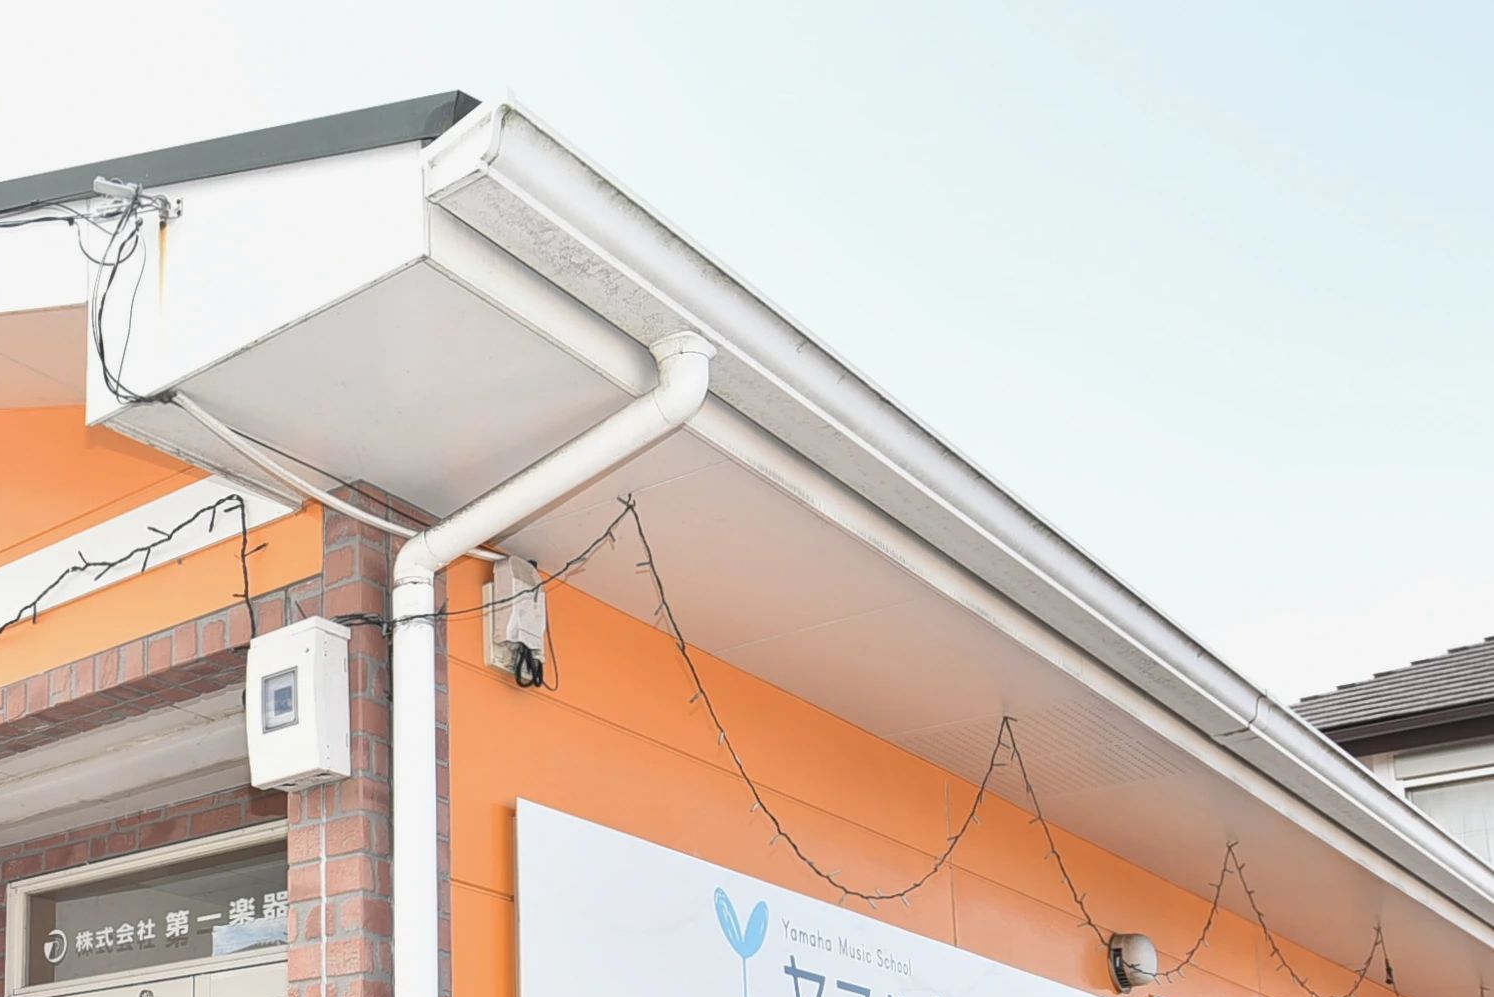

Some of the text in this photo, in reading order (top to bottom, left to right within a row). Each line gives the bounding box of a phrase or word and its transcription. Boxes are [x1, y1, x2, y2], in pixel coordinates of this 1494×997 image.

[75, 918, 156, 953] 株式会社
[782, 918, 912, 977] Yamaha Music School
